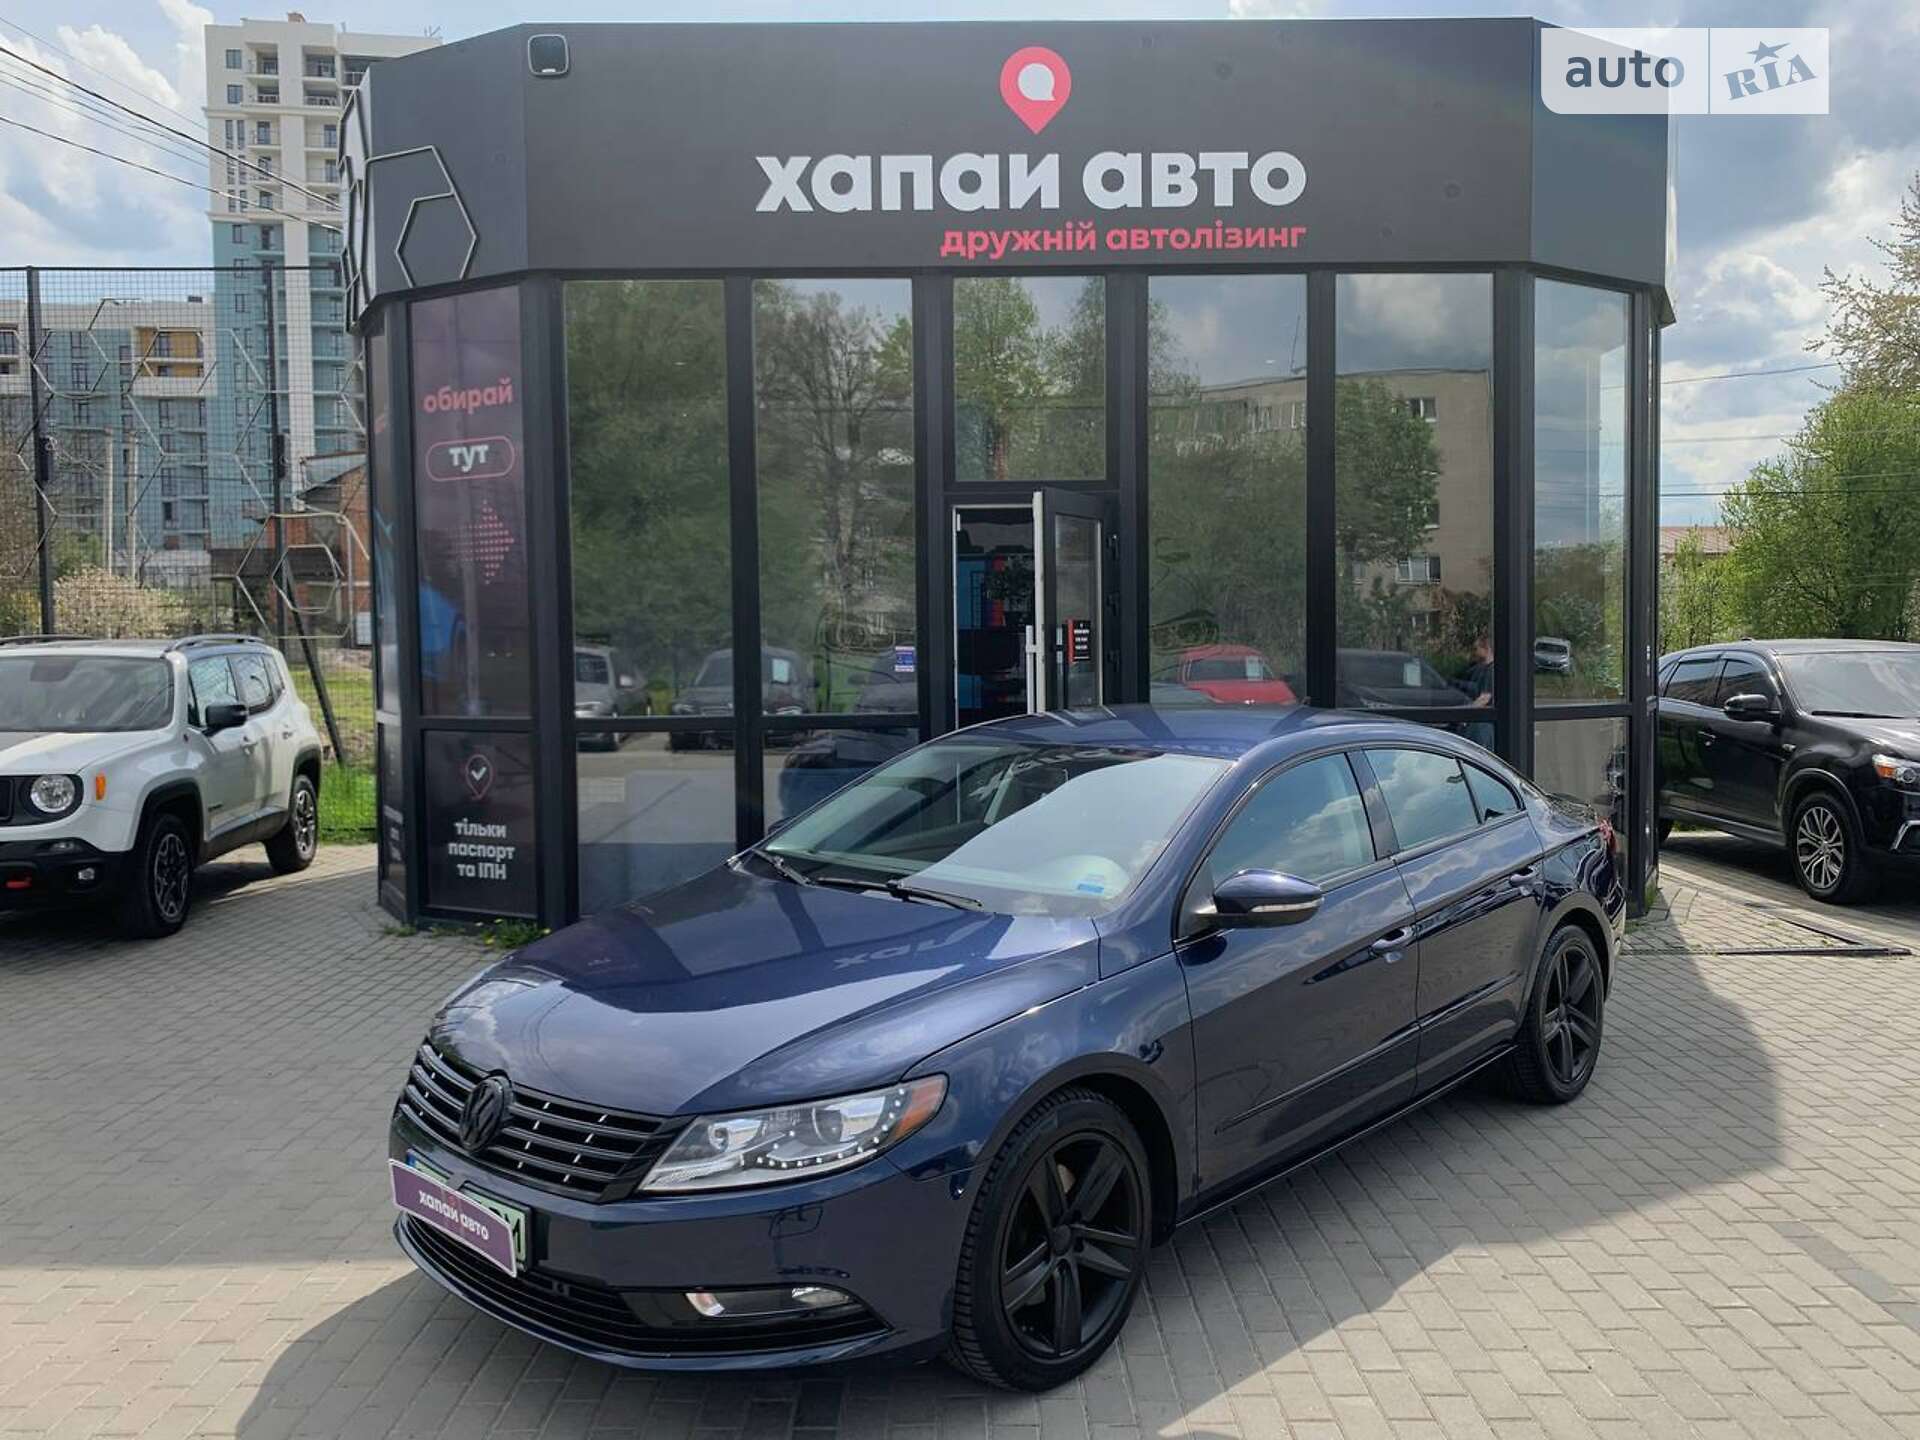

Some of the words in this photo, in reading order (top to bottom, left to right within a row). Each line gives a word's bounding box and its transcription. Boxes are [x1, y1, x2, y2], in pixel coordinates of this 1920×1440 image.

[1082, 150, 1308, 209] авто
[939, 220, 1096, 259] дружній
[1105, 219, 1308, 251] автолізинг
[423, 377, 514, 415] обирай
[449, 444, 489, 473] тут
[453, 817, 508, 839] тільки
[447, 842, 516, 863] паспорт
[456, 863, 476, 878] та
[478, 862, 507, 880] ІПН
